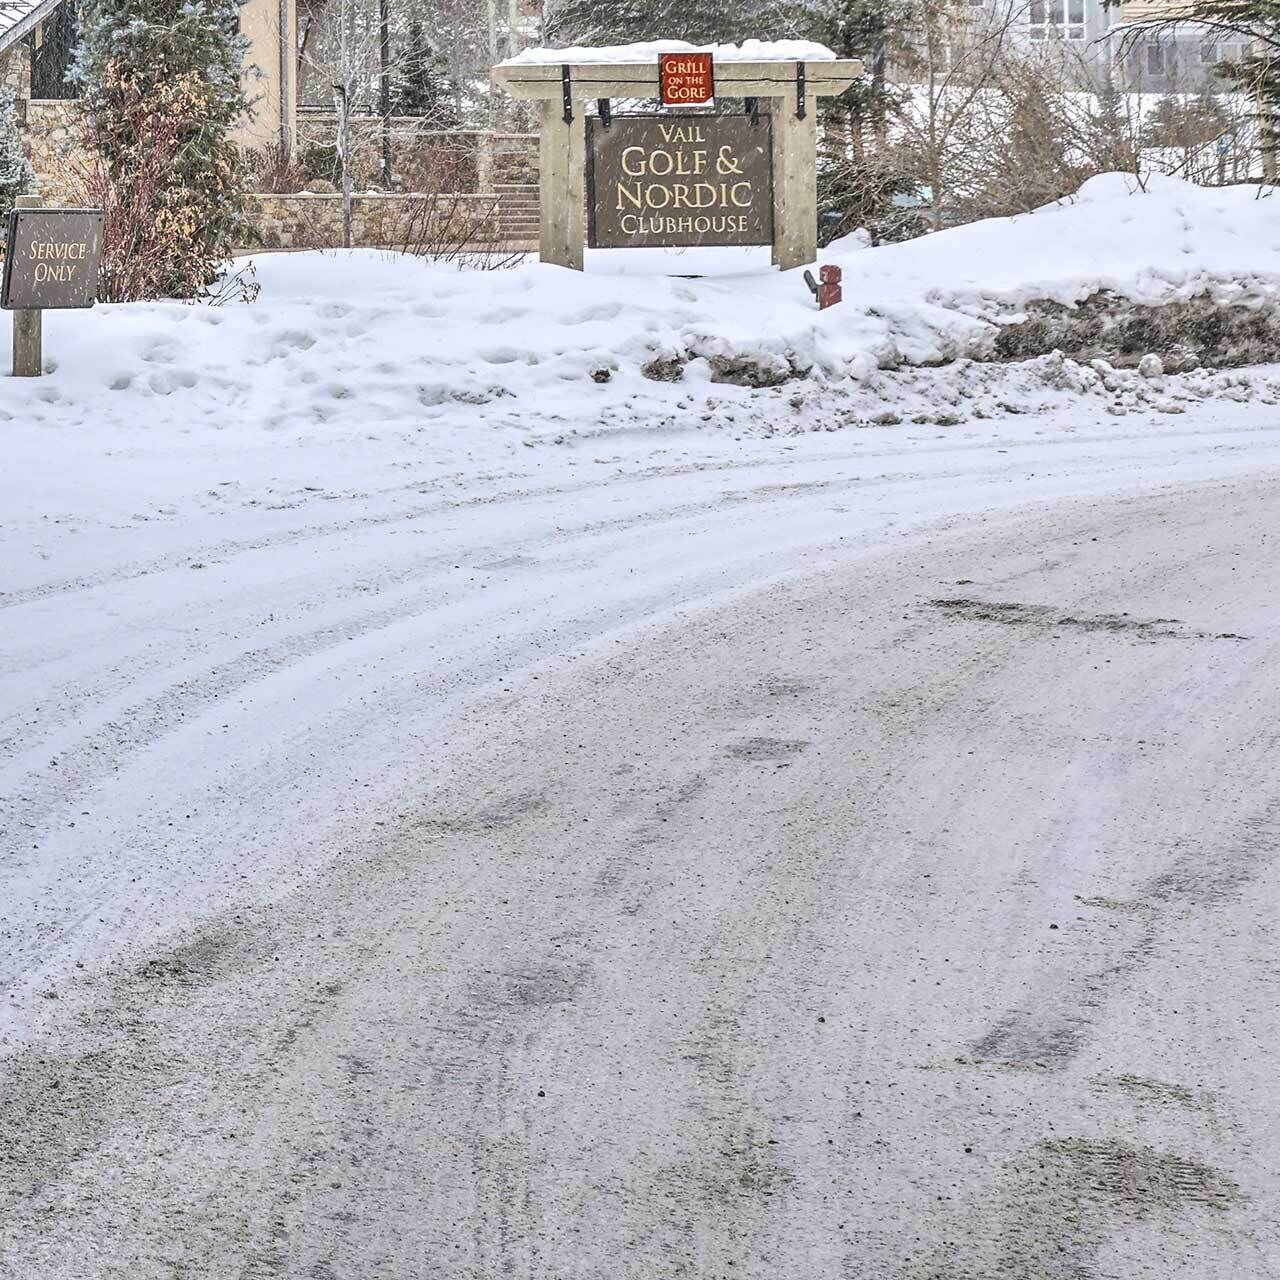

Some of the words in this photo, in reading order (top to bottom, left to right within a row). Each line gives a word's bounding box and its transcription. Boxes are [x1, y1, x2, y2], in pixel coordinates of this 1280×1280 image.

[665, 60, 707, 74] GRILL
[685, 76, 704, 85] THE
[667, 85, 706, 99] GORE
[658, 123, 706, 143] VAIL
[621, 146, 707, 176] GOLF
[716, 145, 744, 175] &
[615, 181, 753, 210] NORDIC
[620, 214, 749, 234] CLUBHOUSE
[29, 240, 87, 260] SERVICE
[34, 262, 77, 282] ONLY
